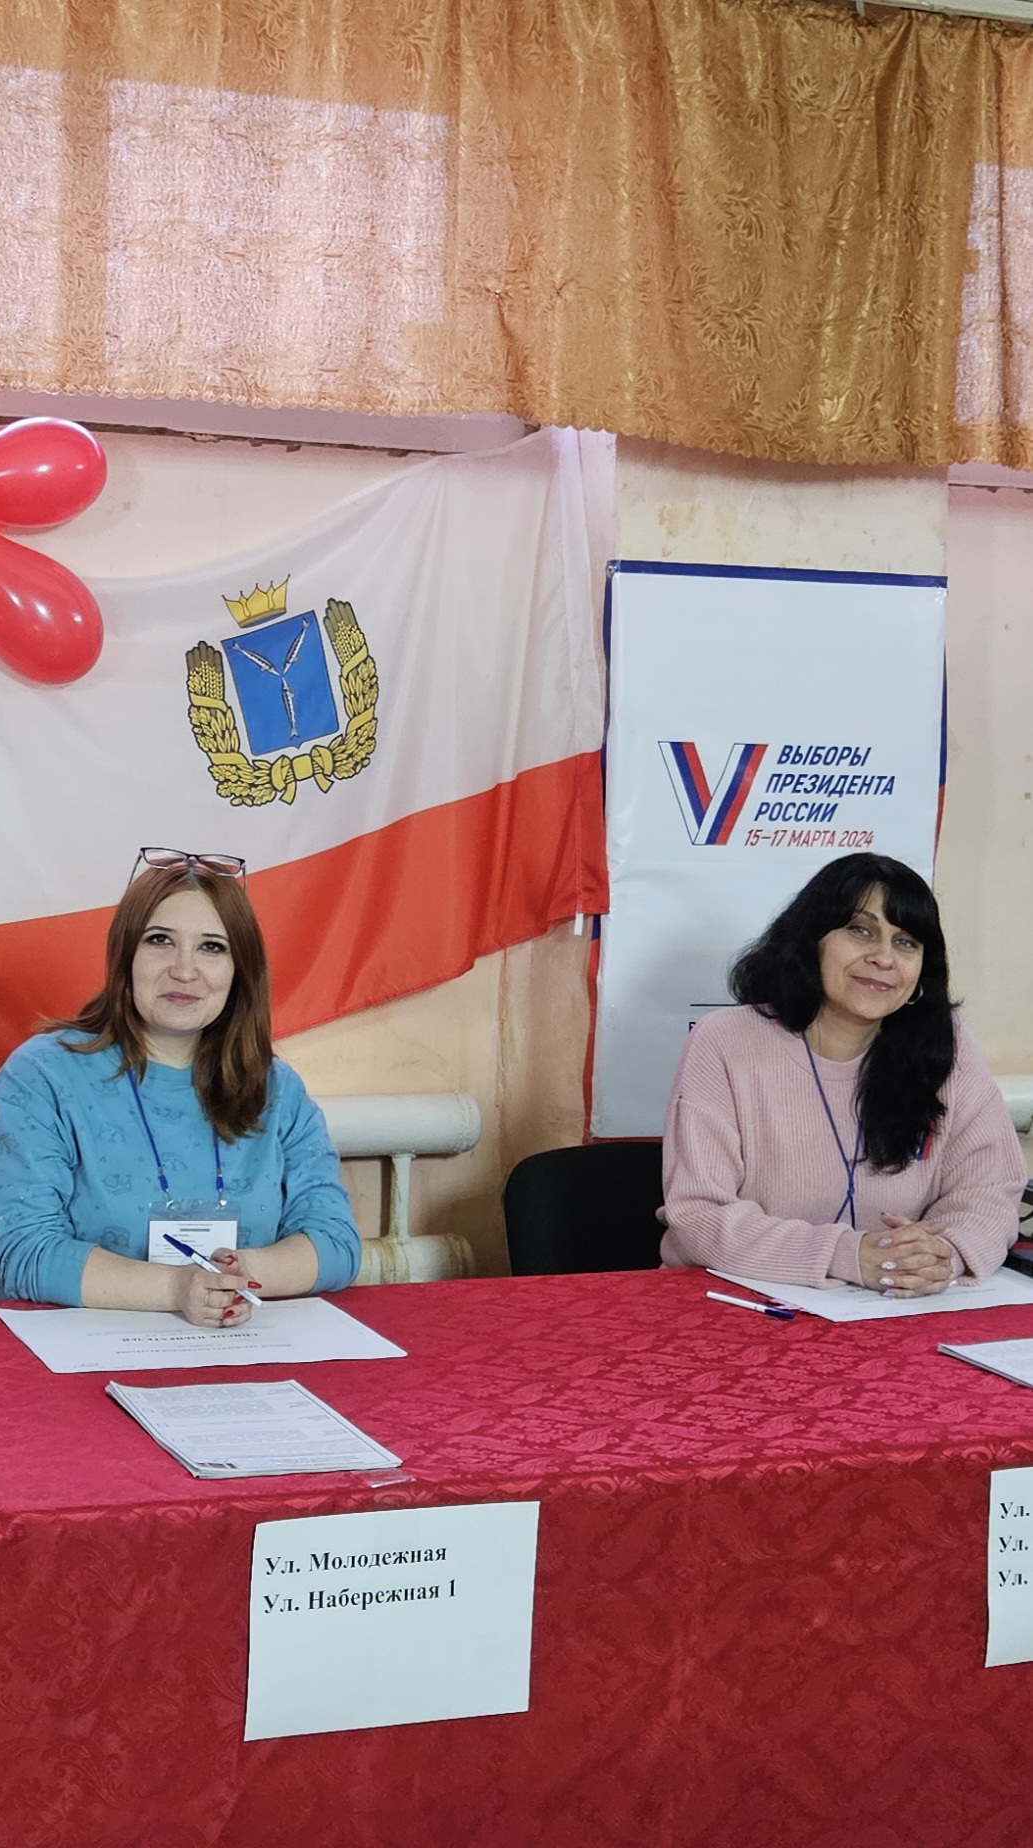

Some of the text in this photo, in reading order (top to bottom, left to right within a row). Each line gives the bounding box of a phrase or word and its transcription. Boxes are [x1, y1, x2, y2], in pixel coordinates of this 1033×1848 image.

[776, 744, 873, 767] ВЫБОРЫ
[764, 773, 896, 799] ПРЕЗИДЕНТА
[753, 801, 839, 823] РОССИИ
[788, 829, 836, 848] МАРТА
[837, 830, 875, 848] 2024
[999, 1501, 1031, 1520] Ул.
[998, 1535, 1029, 1554] Ул.
[264, 1547, 447, 1576] Ул. Молодежная
[997, 1569, 1028, 1588] Ул.
[262, 1578, 457, 1614] Ул. Набережная 1
